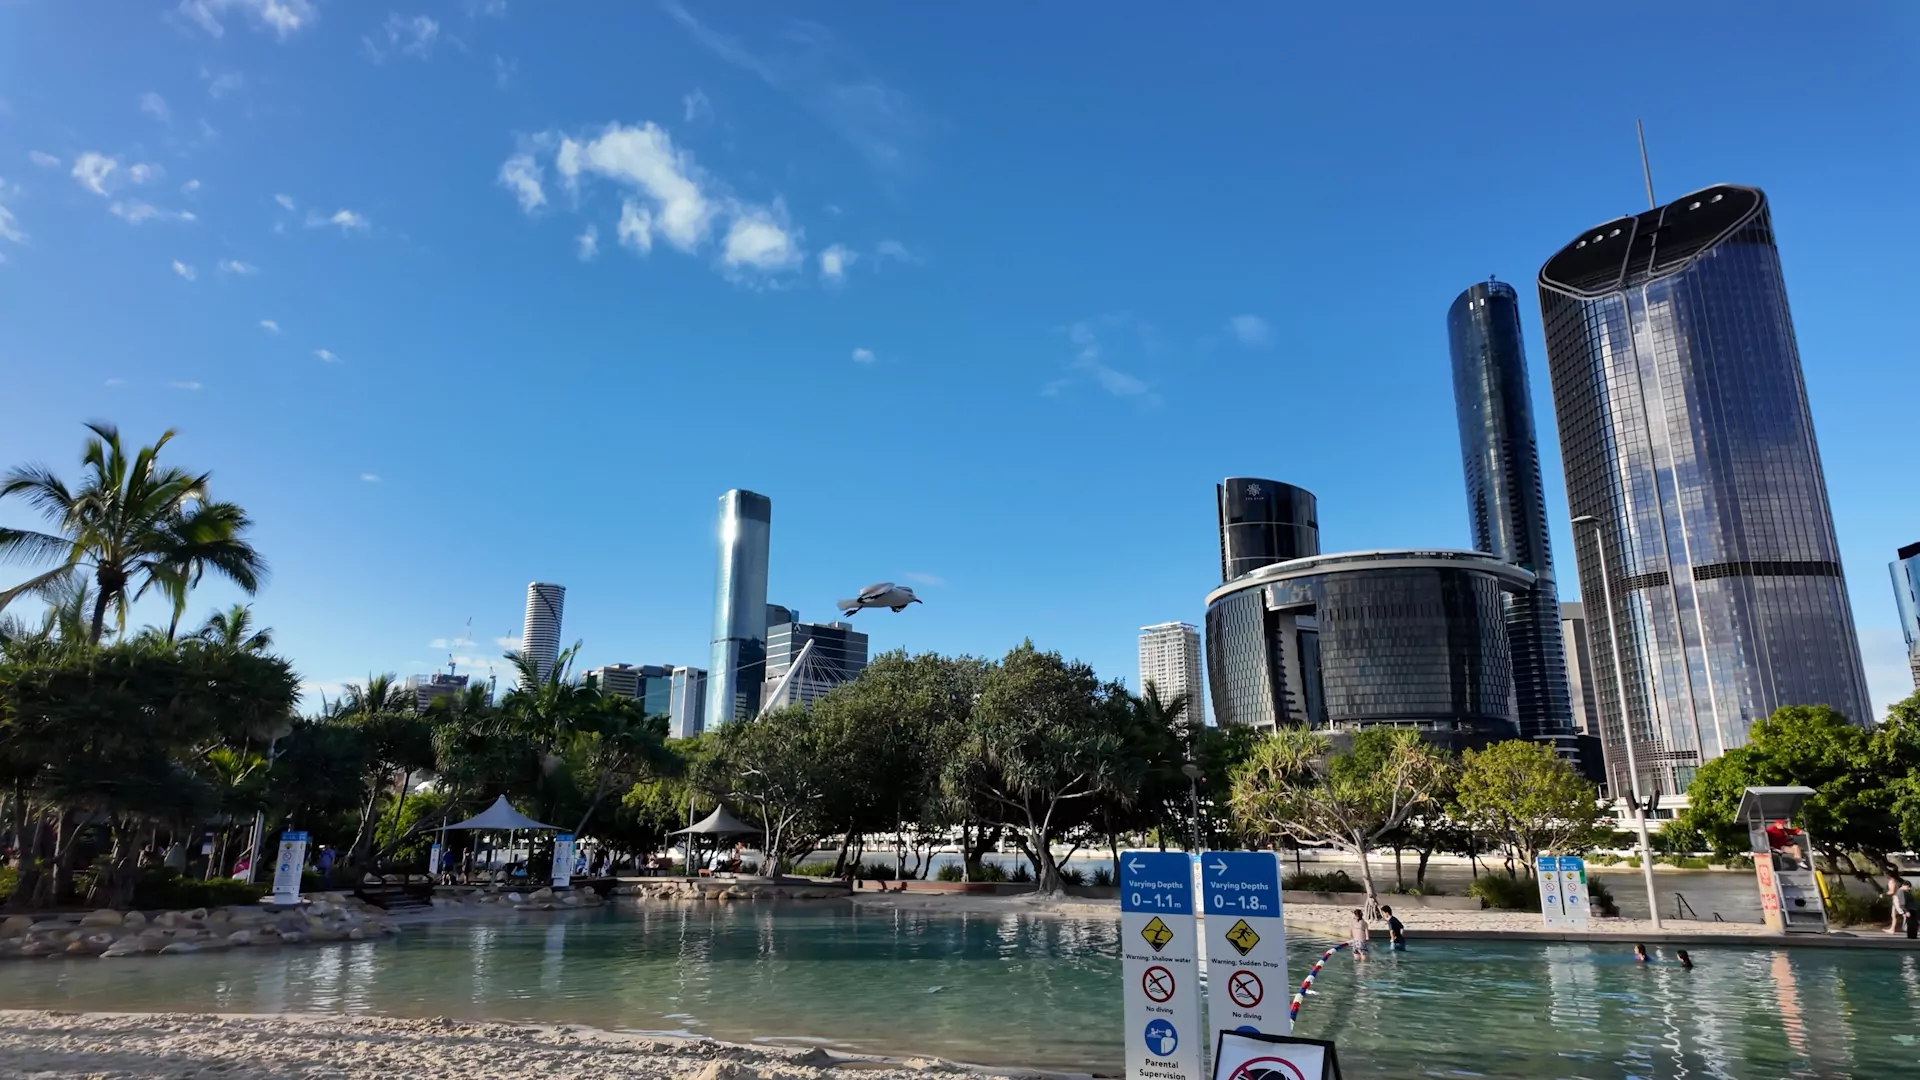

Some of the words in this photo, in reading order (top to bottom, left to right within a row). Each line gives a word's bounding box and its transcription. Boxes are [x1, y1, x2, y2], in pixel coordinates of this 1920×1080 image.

[1129, 880, 1156, 889] Varying
[1157, 881, 1183, 890] Depths
[1210, 881, 1240, 891] Varying
[1241, 882, 1269, 891] Depths
[1156, 1006, 1174, 1015] diving
[1243, 1012, 1262, 1021] diving
[1145, 1058, 1179, 1069] Parental
[1139, 1068, 1186, 1080] Supervision
